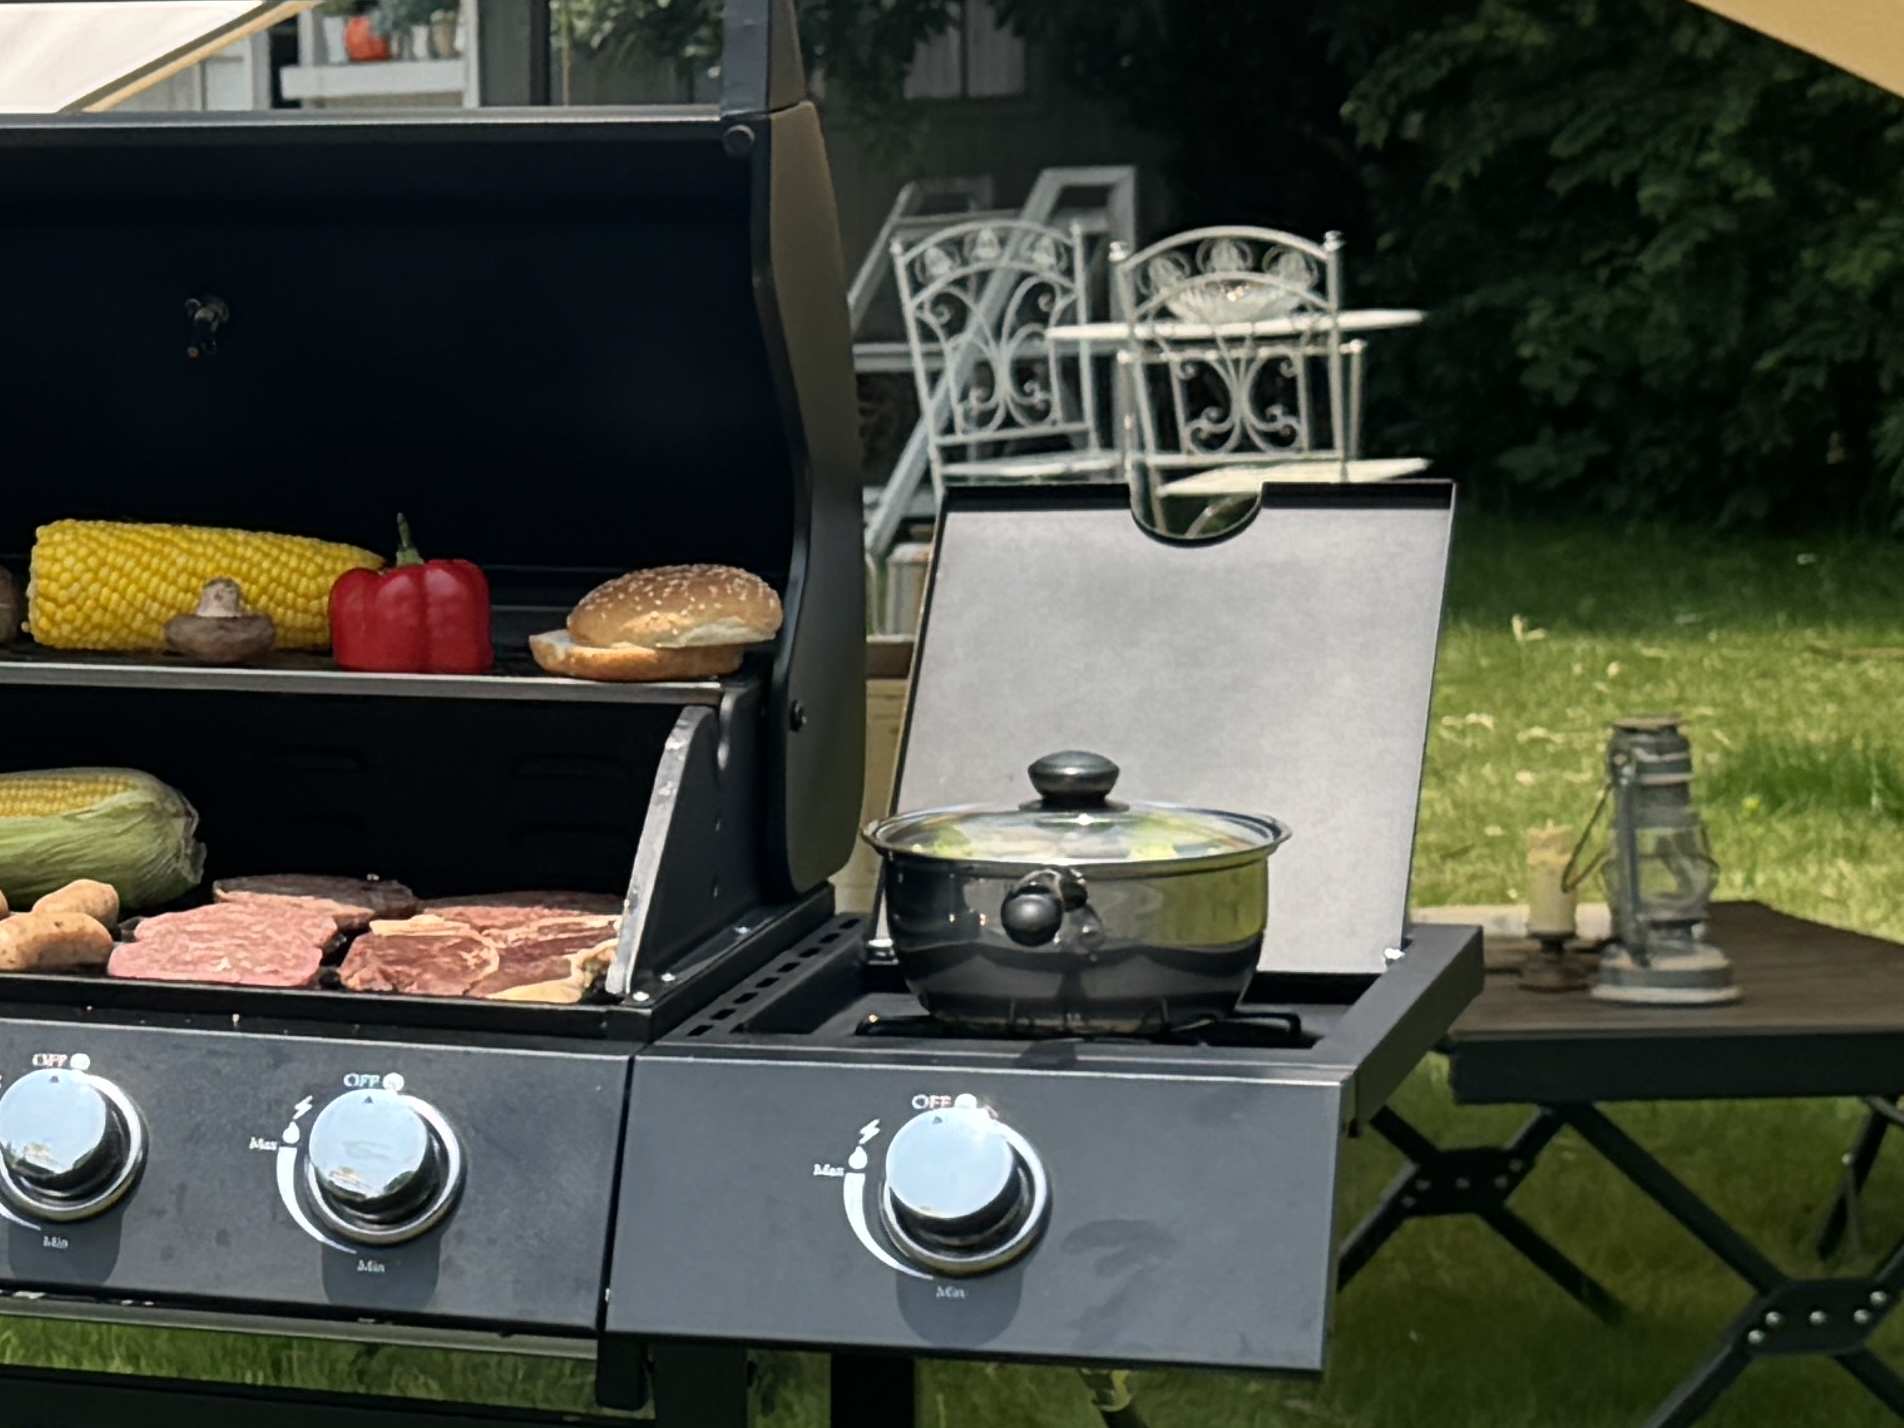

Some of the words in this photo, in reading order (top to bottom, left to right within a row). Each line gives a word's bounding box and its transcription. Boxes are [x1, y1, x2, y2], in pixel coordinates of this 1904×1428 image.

[32, 1053, 68, 1068] OFF
[343, 1073, 381, 1088] OFF
[911, 1094, 952, 1109] OFF
